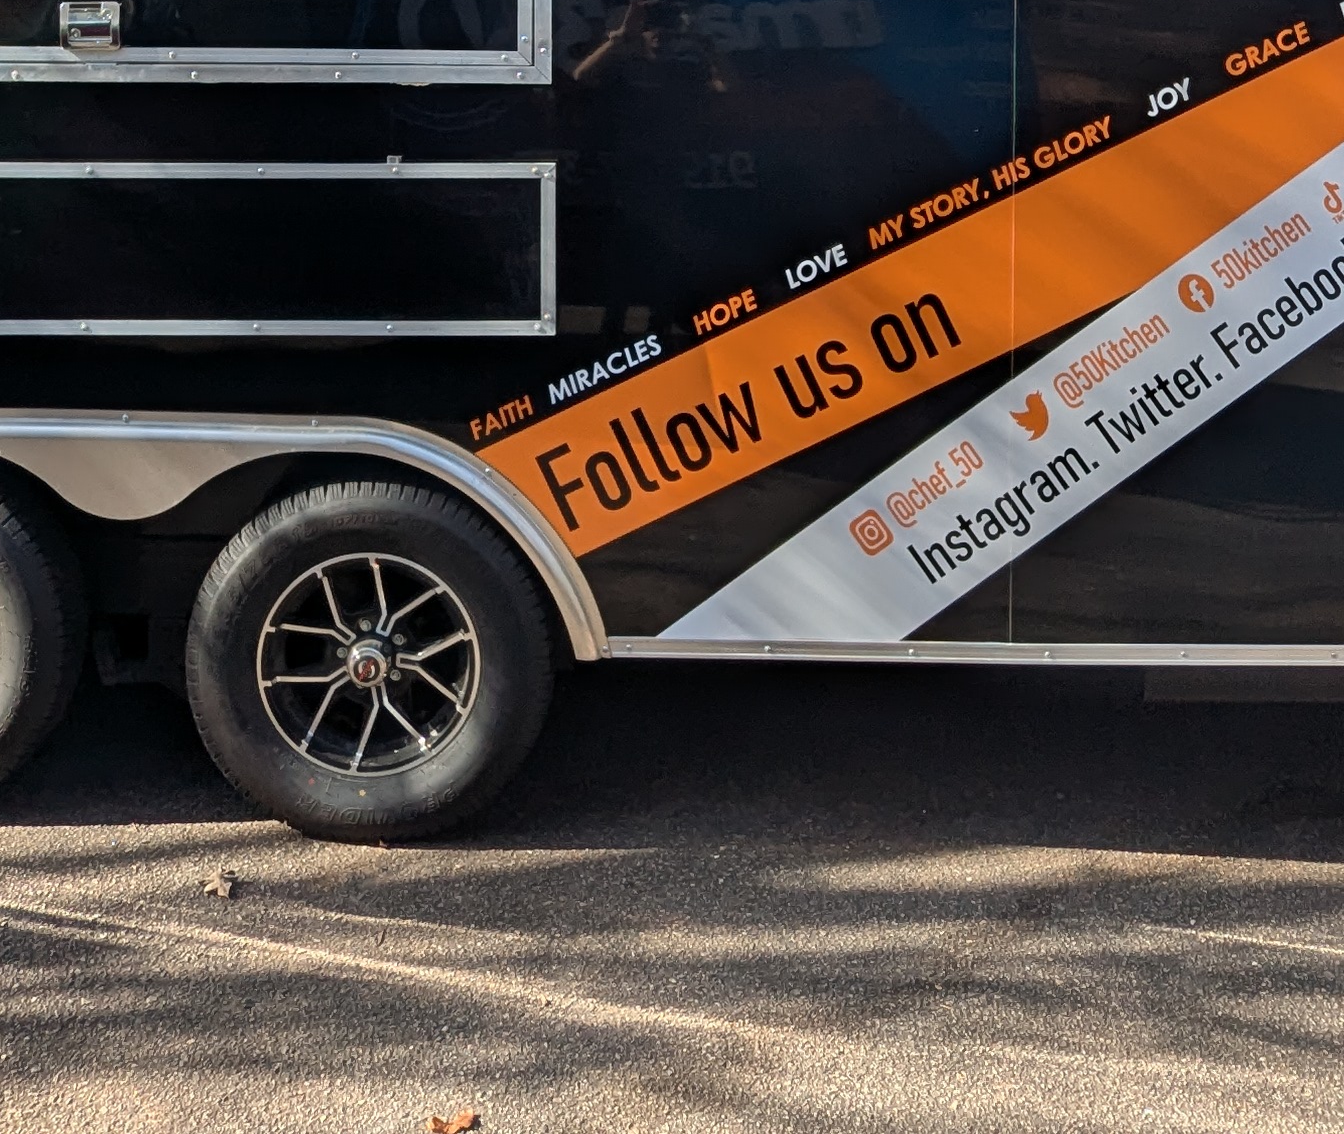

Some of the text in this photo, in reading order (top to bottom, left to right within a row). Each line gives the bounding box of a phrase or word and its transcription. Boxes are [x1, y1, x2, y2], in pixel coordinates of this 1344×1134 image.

[470, 395, 534, 441] FAITH
[548, 334, 662, 406] MIRACLES
[692, 288, 758, 336] HOPE
[785, 243, 848, 289] LOVE
[868, 214, 905, 251] MY
[991, 157, 1031, 192] HIS
[1033, 115, 1112, 169] GLORY
[1146, 77, 1191, 118] JOY
[1224, 21, 1311, 77] GRACE
[886, 440, 985, 528] @chef_50
[1052, 311, 1170, 410] @50Kitchen
[1210, 209, 1312, 290] 50kitchen
[535, 292, 962, 532] Follow us on
[907, 446, 1101, 585] Instagram.
[1084, 354, 1225, 454] Twitter.
